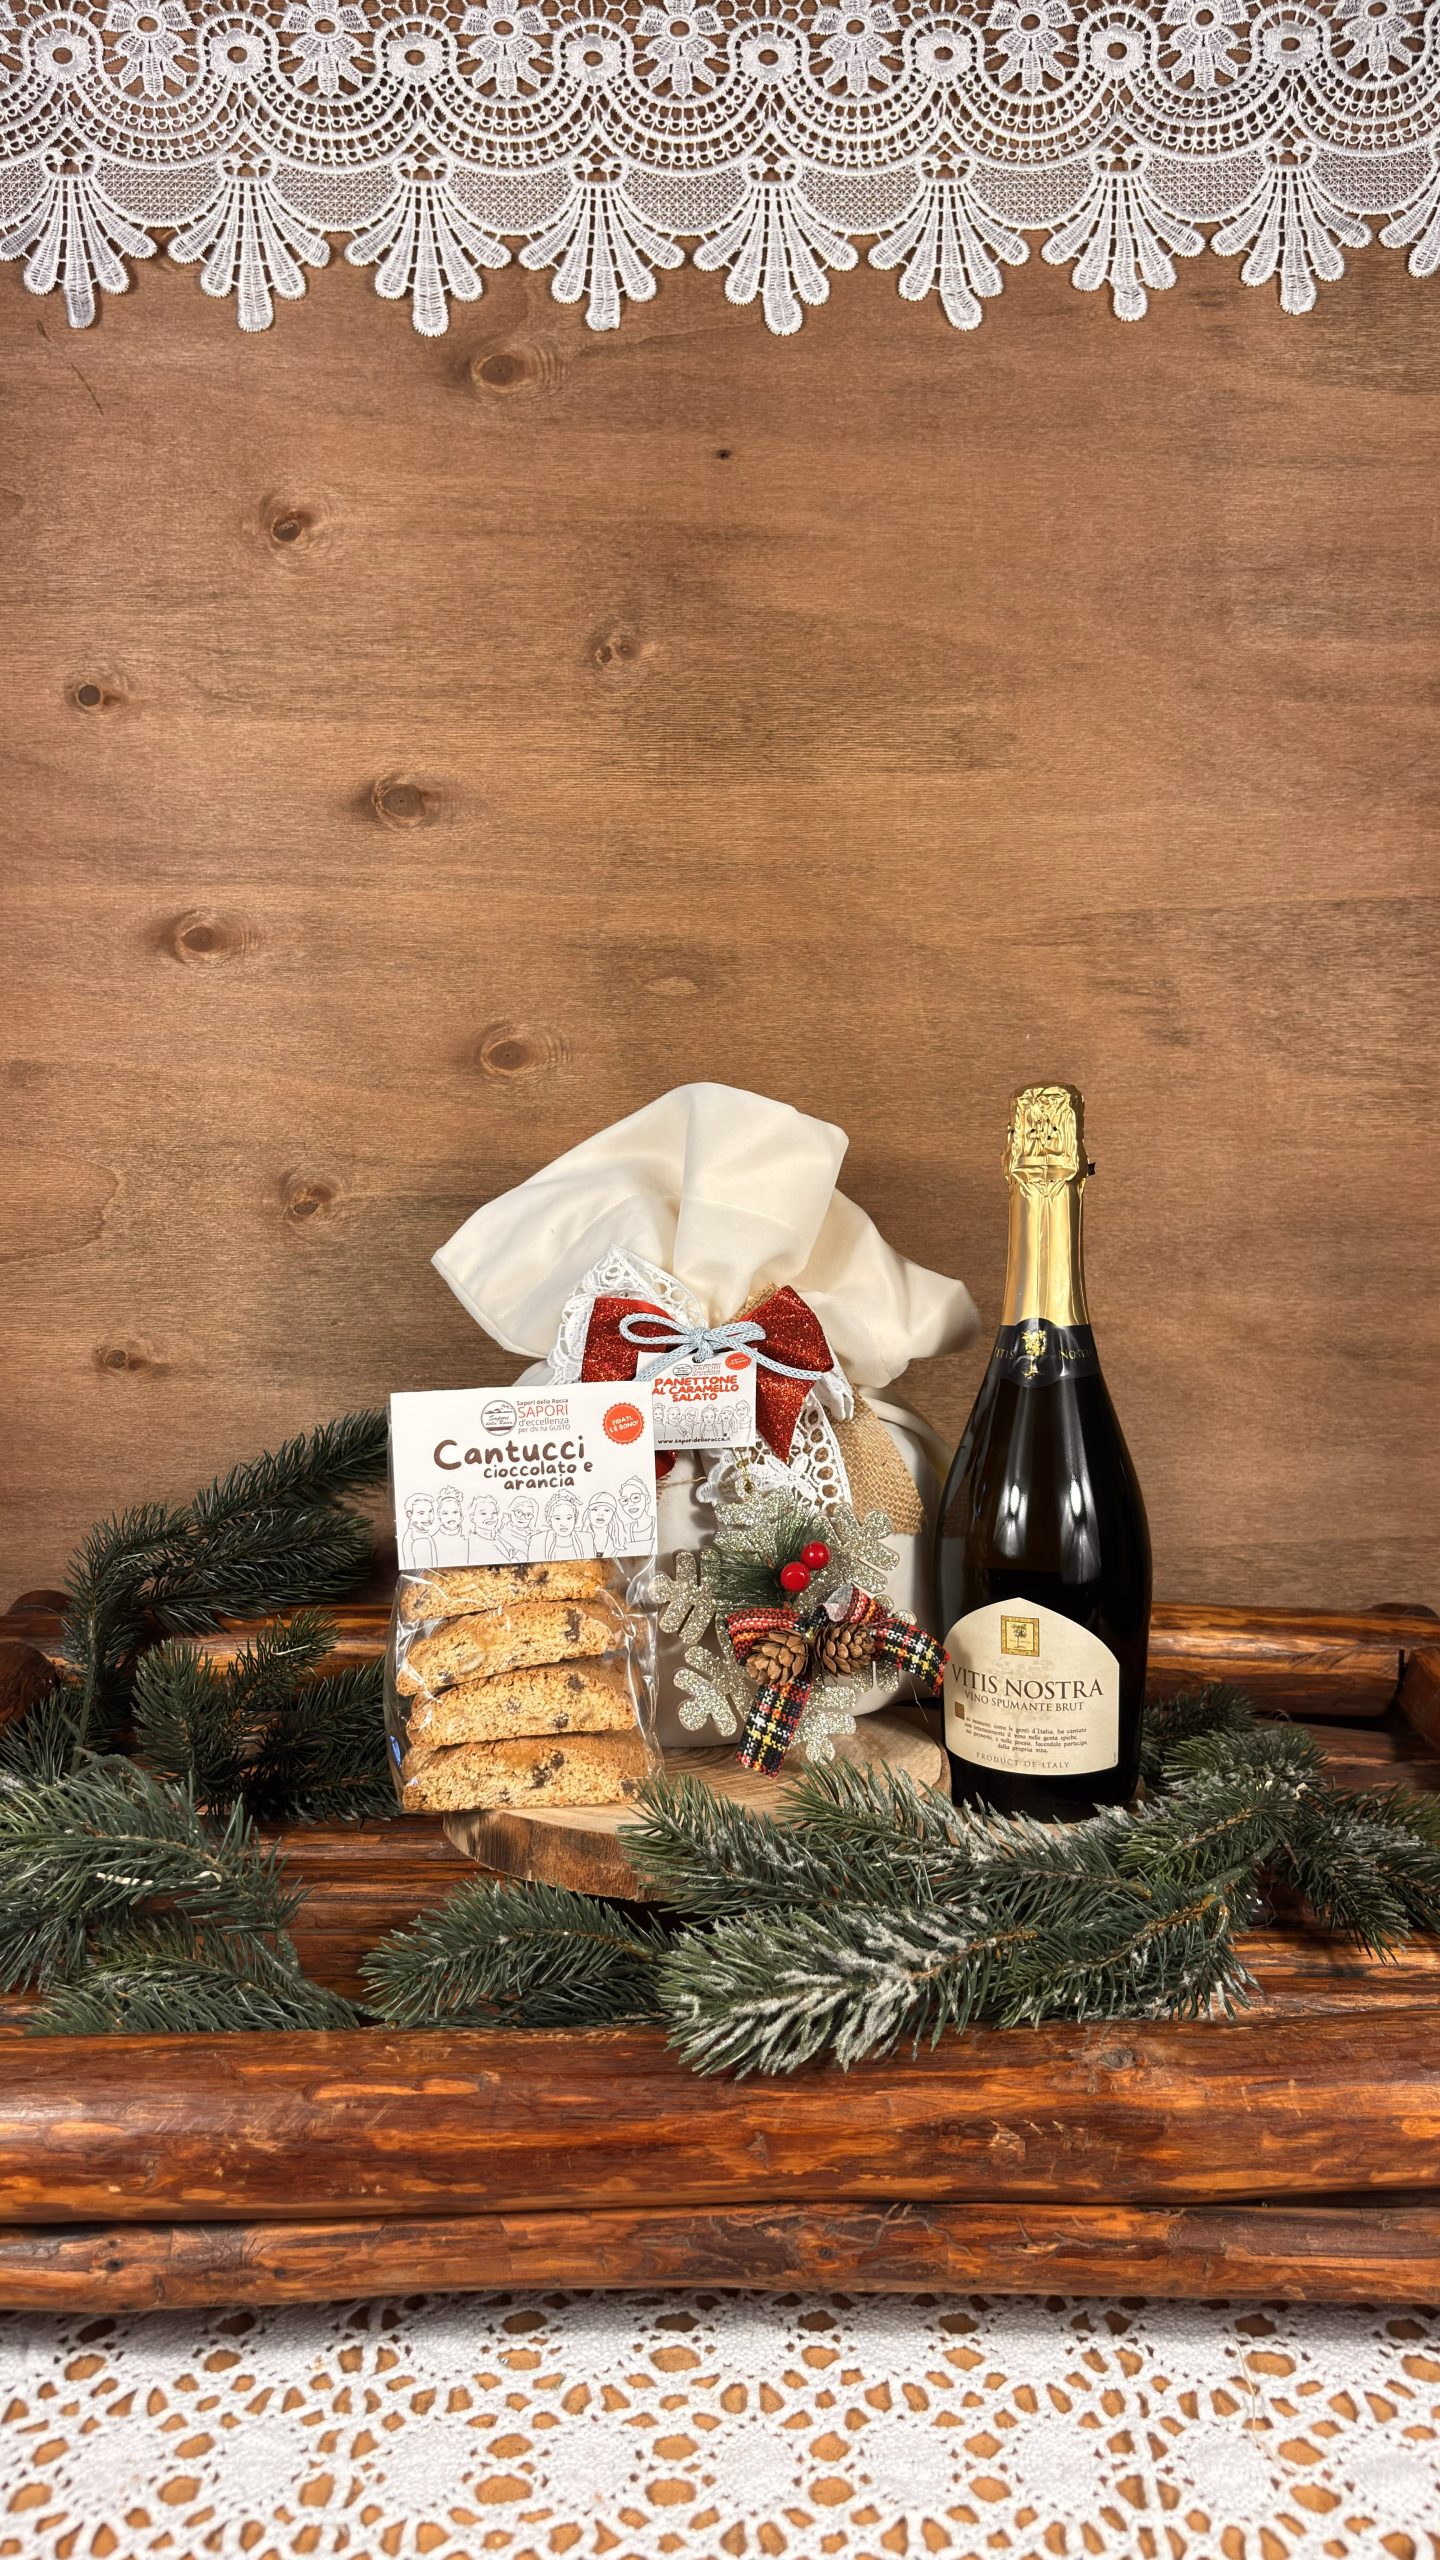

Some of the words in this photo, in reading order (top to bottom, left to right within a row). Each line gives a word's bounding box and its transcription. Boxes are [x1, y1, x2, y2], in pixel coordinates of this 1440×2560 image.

[654, 1374, 738, 1387] PANETTONE
[652, 1386, 666, 1396] AL
[669, 1384, 739, 1395] CARAMELLO
[672, 1392, 718, 1402] SALATO
[518, 1404, 569, 1419] SAPORI
[518, 1417, 569, 1427] d'eccellenza
[619, 1420, 639, 1430] BONO!
[433, 1435, 585, 1470] Cantucci
[483, 1461, 577, 1479] cioccolato
[584, 1461, 593, 1472] e
[503, 1474, 575, 1490] arancia
[951, 1663, 998, 1694] VITIS
[1005, 1678, 1104, 1700] NOSTRA
[964, 1690, 989, 1704] VINO
[991, 1698, 1052, 1712] SPUMANTE
[1056, 1702, 1085, 1712] BRUT
[976, 1751, 1019, 1766] PRODUCT
[1042, 1761, 1070, 1769] ITALY
